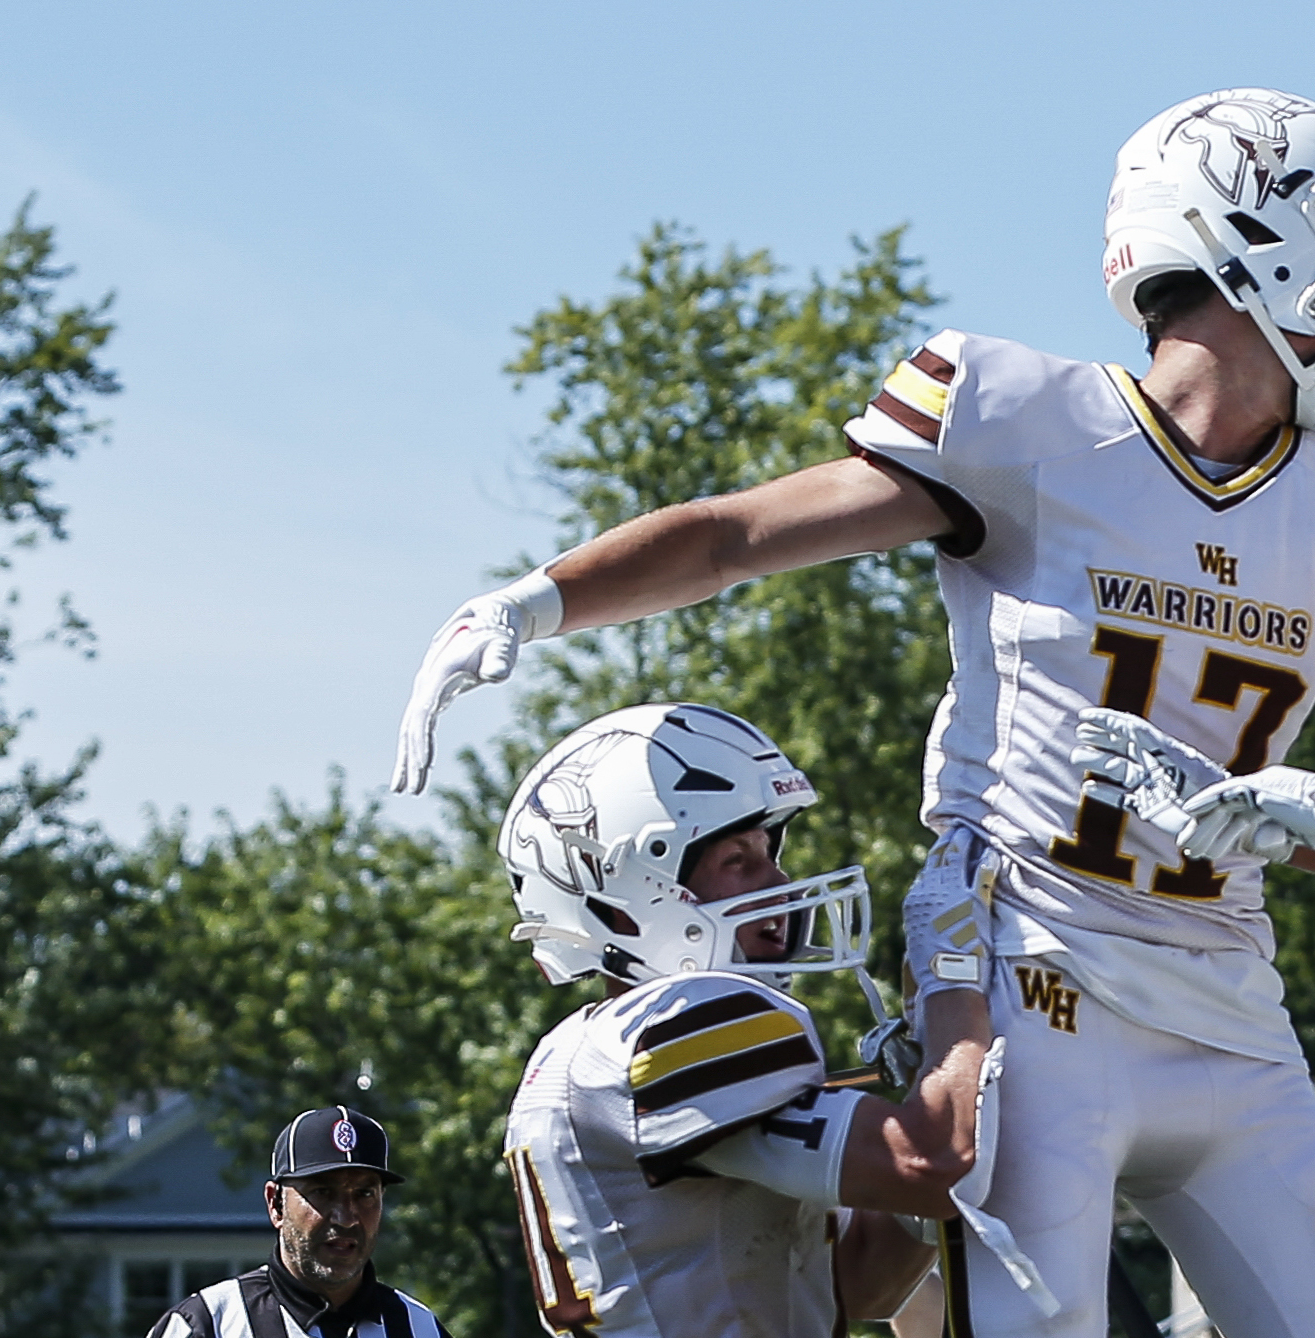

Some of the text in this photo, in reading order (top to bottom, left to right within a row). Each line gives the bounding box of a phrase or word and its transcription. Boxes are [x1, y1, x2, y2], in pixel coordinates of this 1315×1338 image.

[1194, 541, 1239, 588] WH
[1088, 569, 1310, 654] WARRIORS
[1048, 623, 1309, 900] 17
[1013, 964, 1082, 1035] WH
